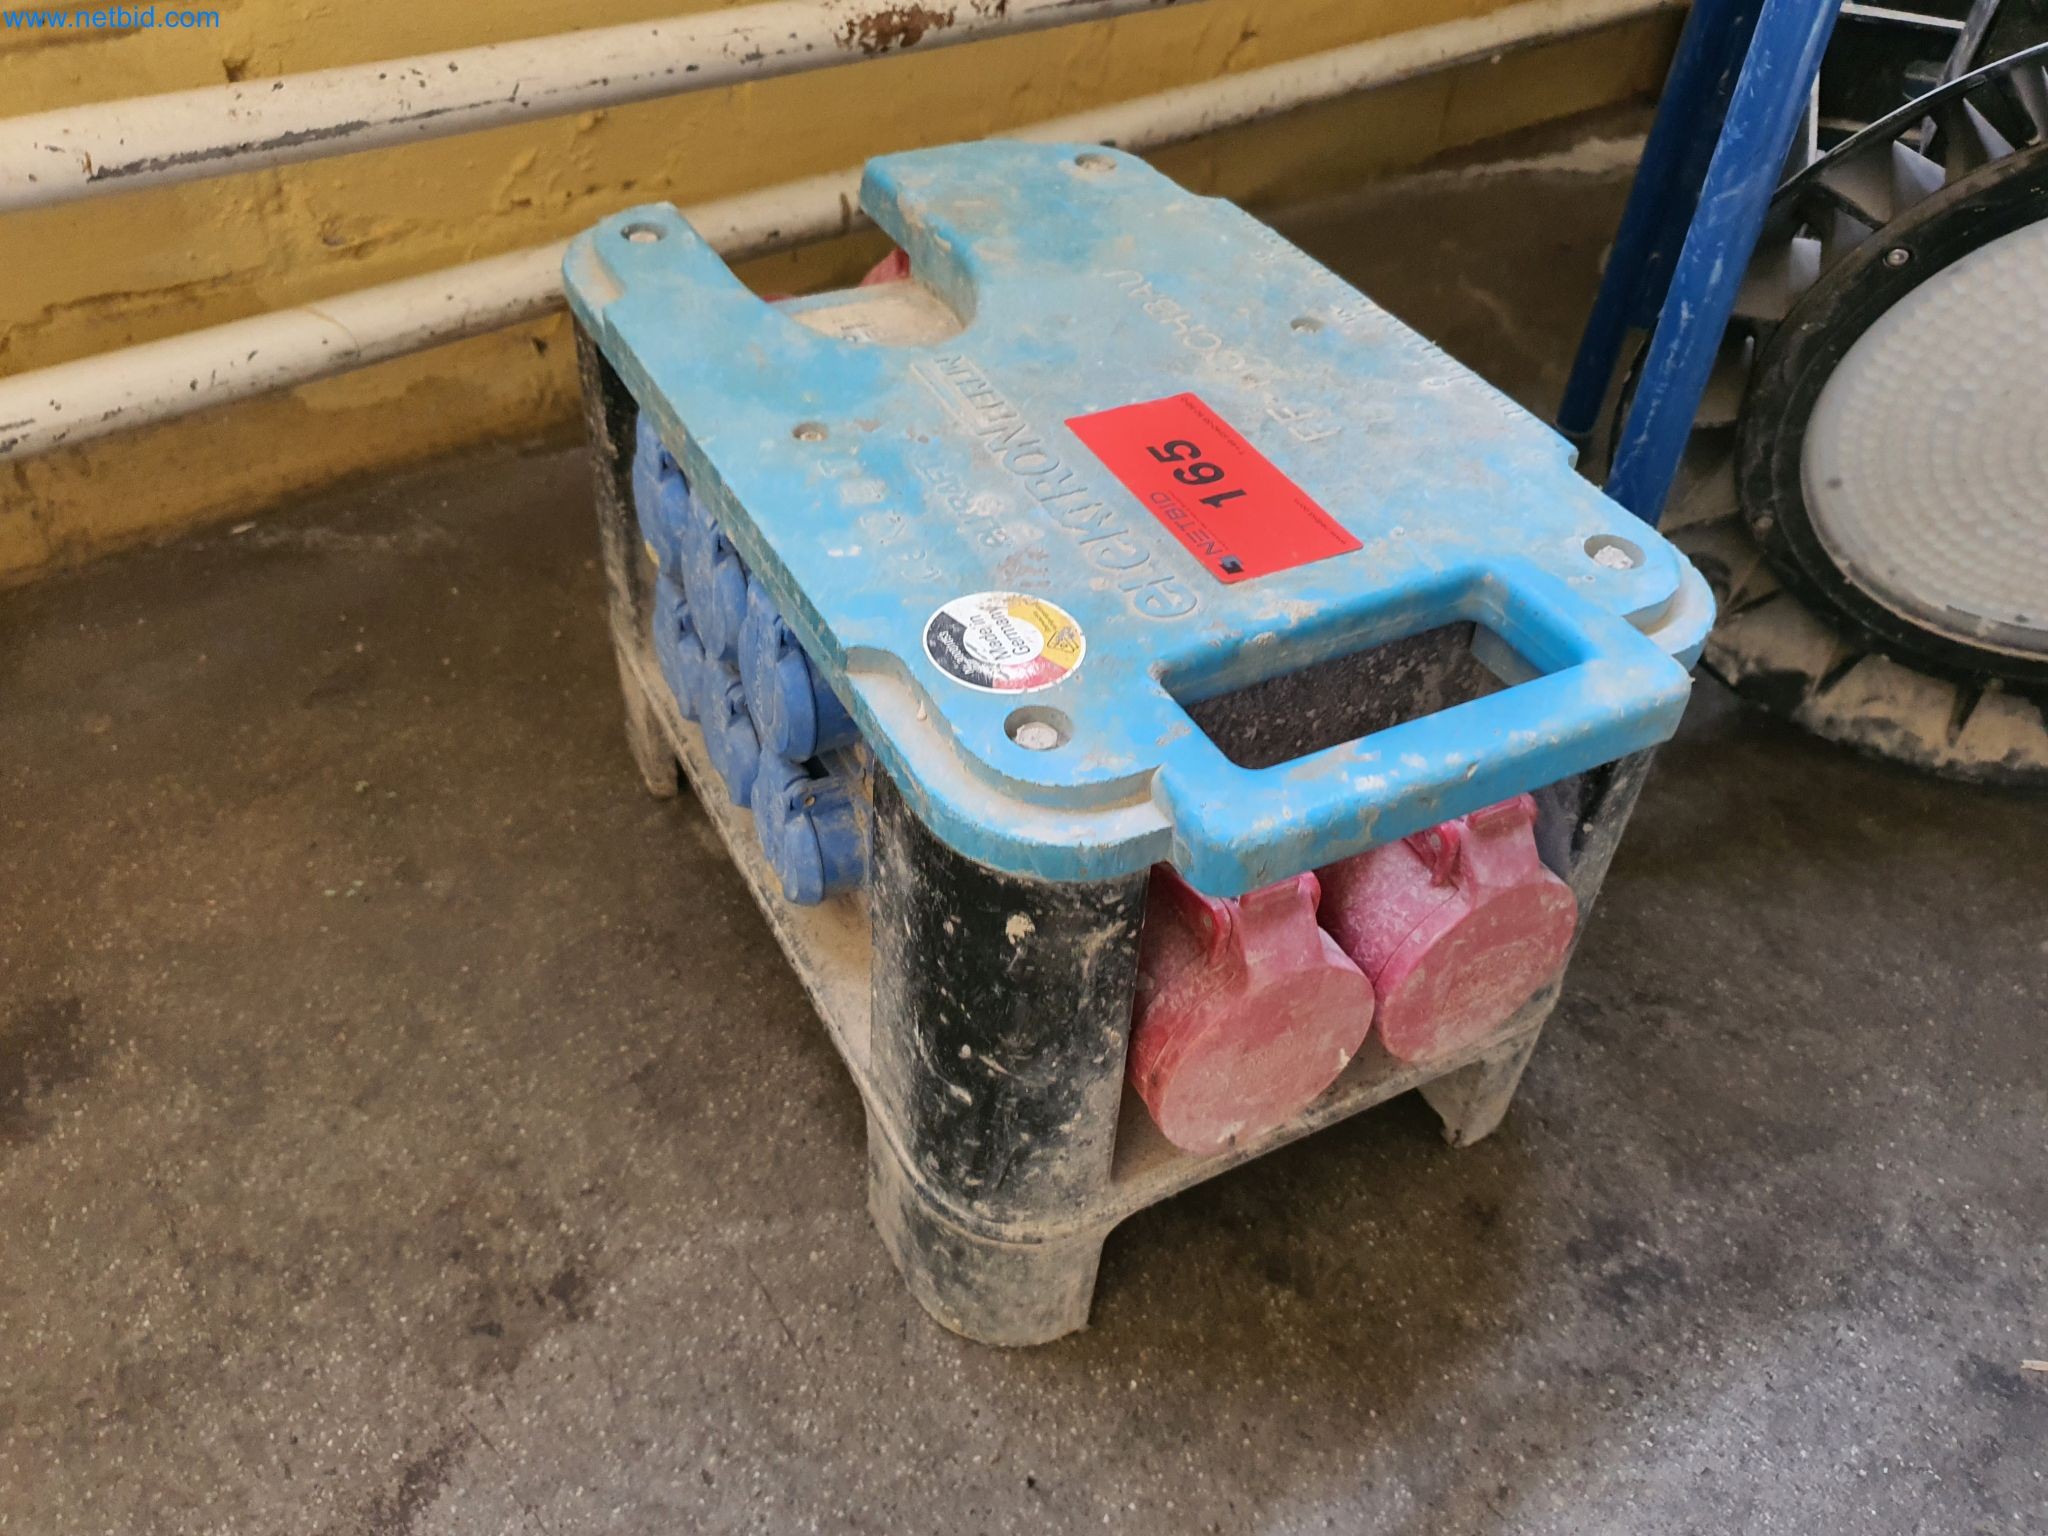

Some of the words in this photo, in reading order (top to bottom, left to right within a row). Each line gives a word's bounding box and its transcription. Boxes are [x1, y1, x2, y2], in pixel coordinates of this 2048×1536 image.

[1146, 438, 1248, 510] 165
[1151, 490, 1218, 557] NETBID
[969, 614, 986, 628] in
[979, 627, 1012, 661] Made
[988, 605, 1032, 656] Germany
